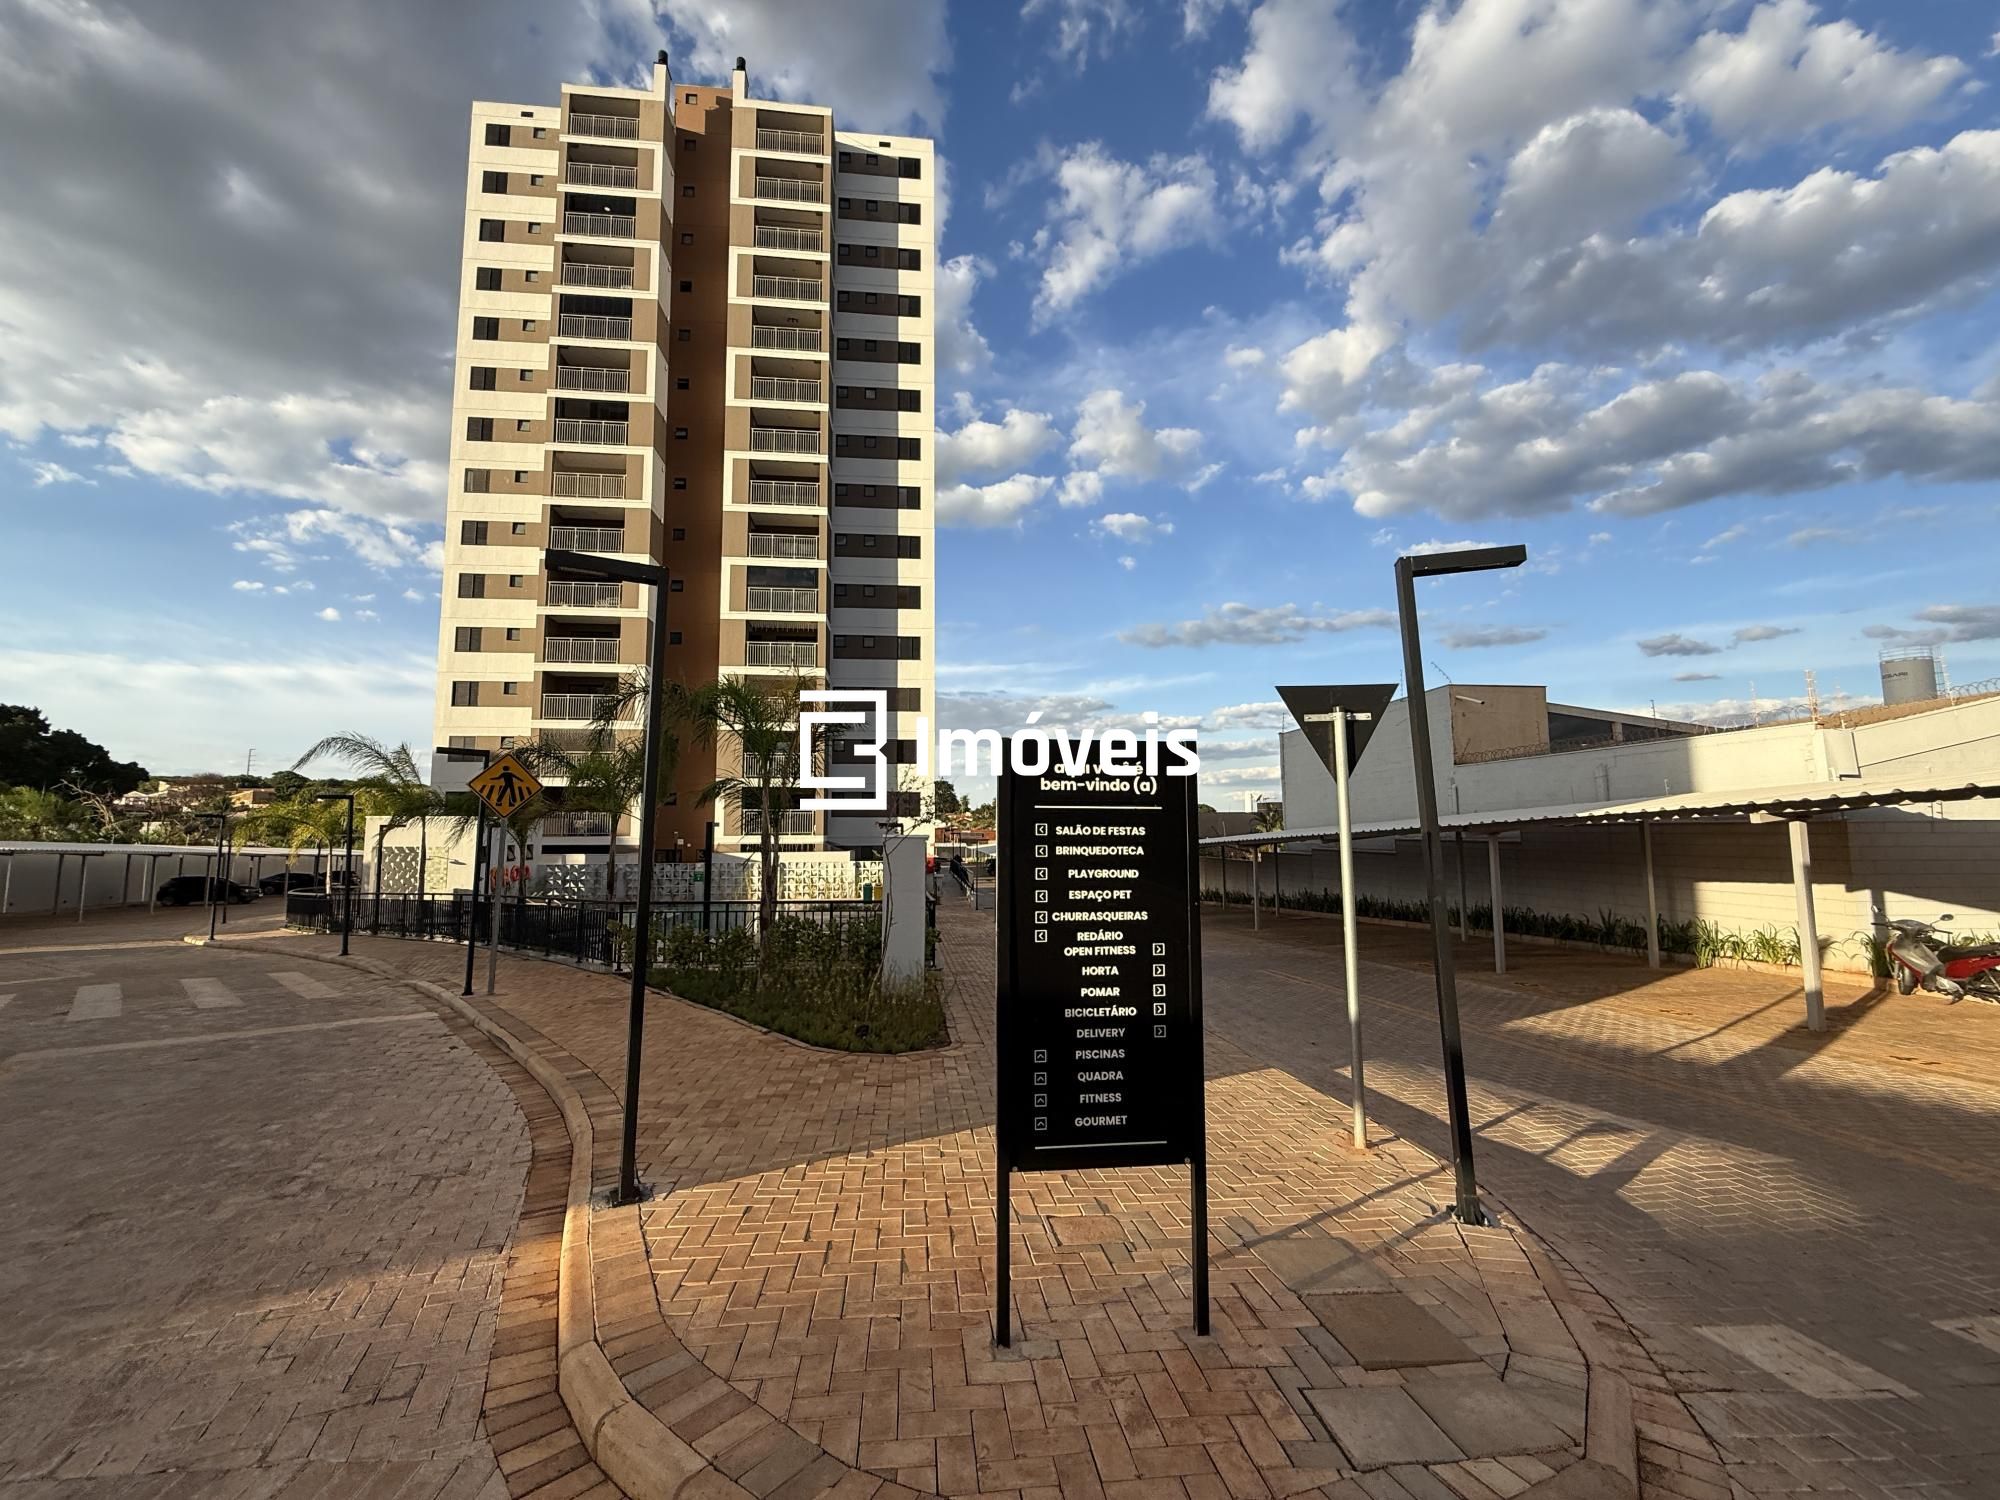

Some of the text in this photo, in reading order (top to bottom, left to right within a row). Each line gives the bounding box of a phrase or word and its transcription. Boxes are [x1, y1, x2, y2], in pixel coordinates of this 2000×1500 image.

[1040, 776, 1158, 795] bem-vindo (a)
[1055, 824, 1146, 836] SALÃO DE FESTAS
[1055, 845, 1145, 857] BRINQUEDOTECA
[1068, 868, 1140, 879] PLAYGROUND
[1068, 889, 1133, 902] ESPAÇO PET
[1051, 910, 1149, 923] CHURRASQUEIRAS
[1076, 928, 1124, 941] REDÁRIO
[1063, 945, 1137, 957] OPEN FITNESS
[1081, 965, 1120, 976] HORTA
[1080, 986, 1121, 998] POMAR
[1064, 1004, 1138, 1018] BICICLETÁRIO
[1076, 1027, 1126, 1039] DELIVERY
[1075, 1048, 1126, 1060] PISCINAS
[1077, 1070, 1124, 1083] QUADRA
[1079, 1092, 1122, 1104] FITNESS
[1074, 1115, 1128, 1127] GOURMET
